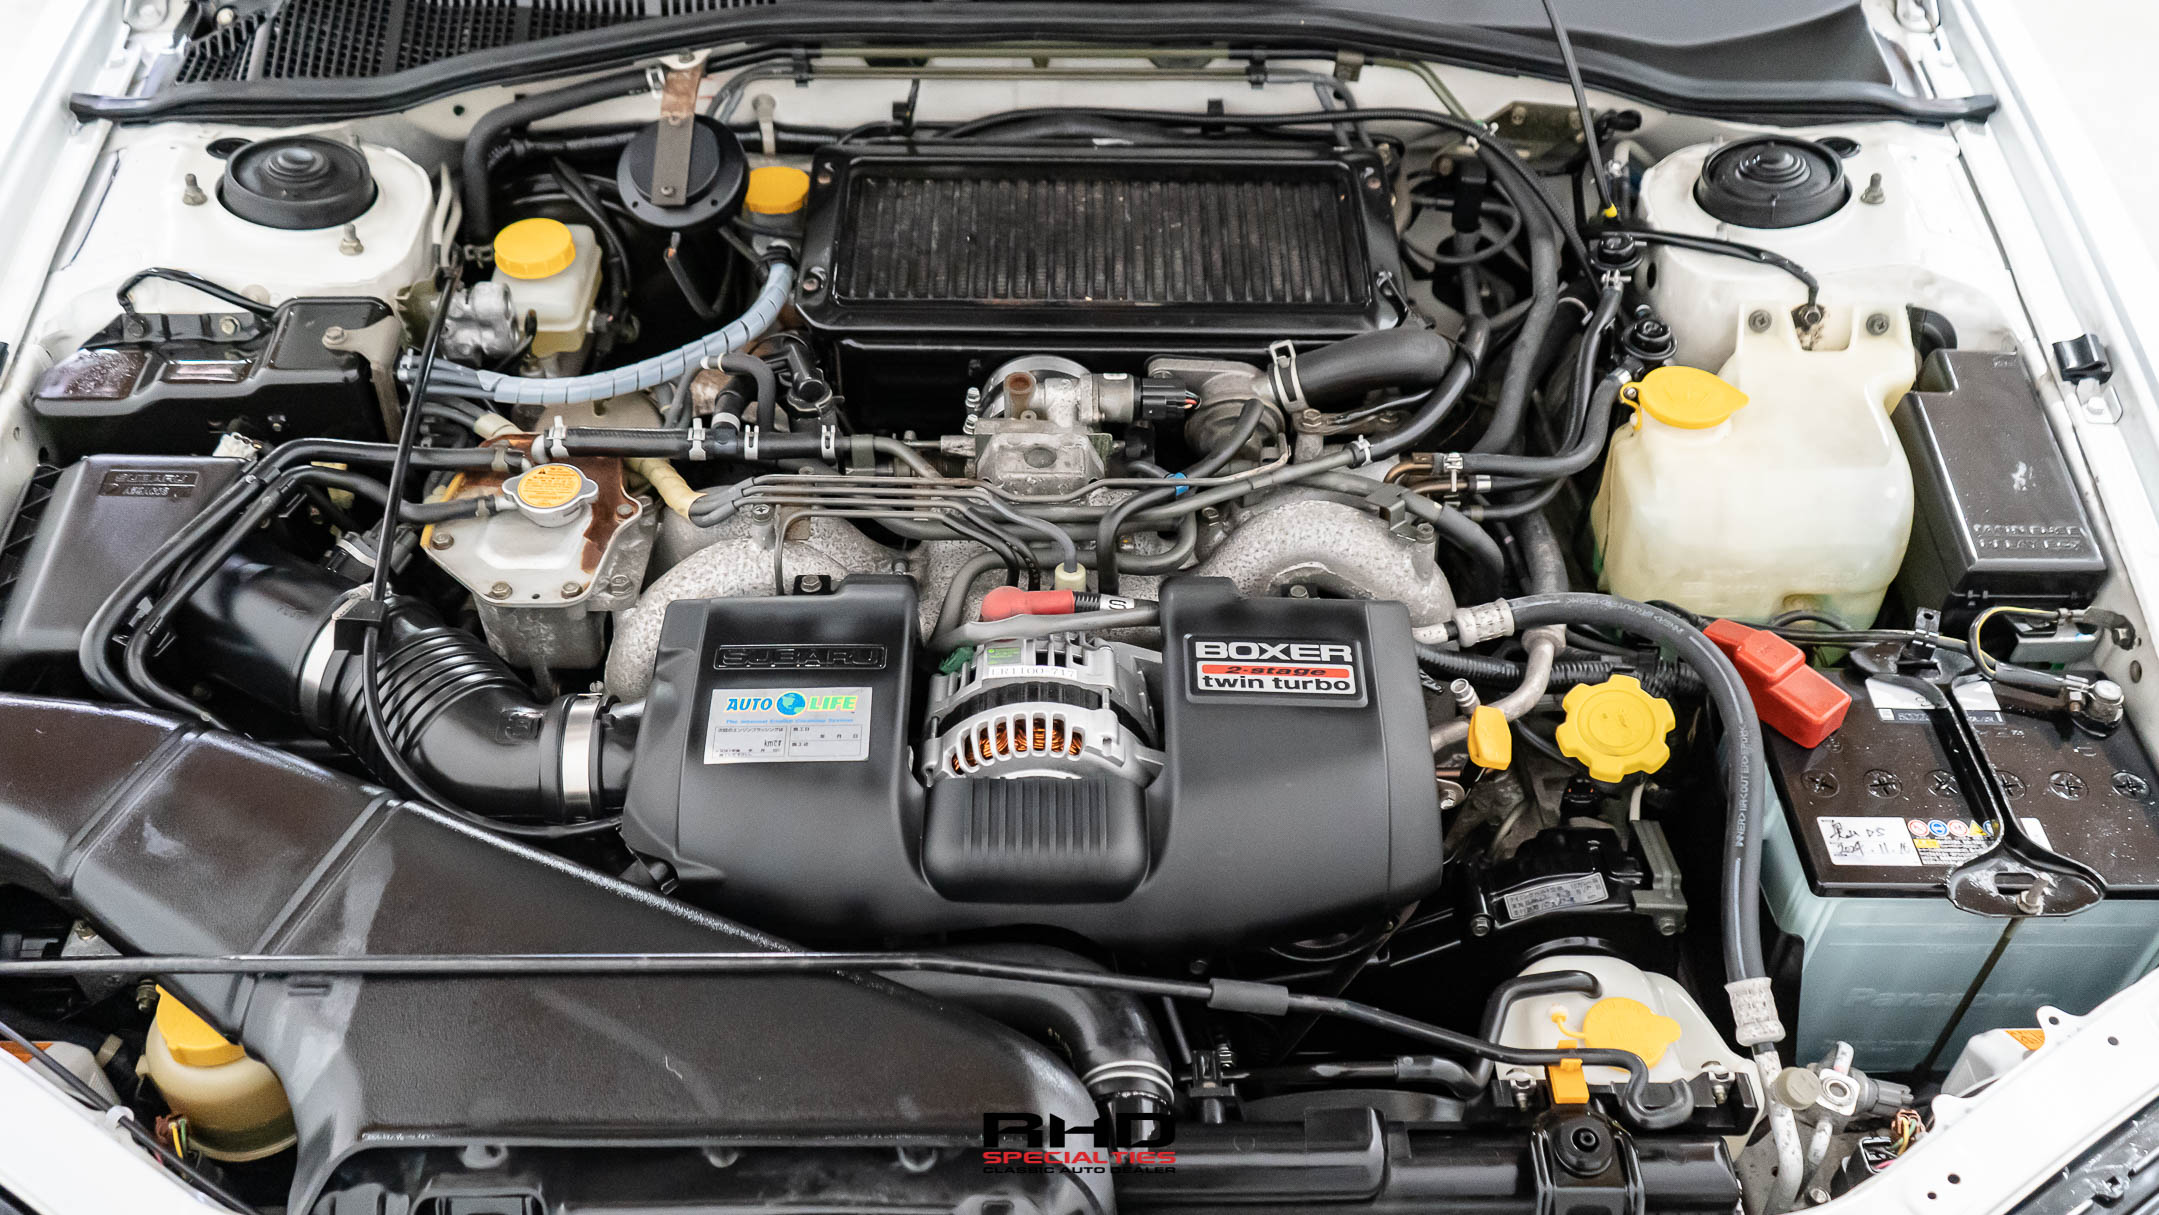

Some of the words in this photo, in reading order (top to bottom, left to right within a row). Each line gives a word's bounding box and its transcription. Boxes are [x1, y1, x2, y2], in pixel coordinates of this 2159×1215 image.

[722, 648, 880, 668] SUBARU
[1195, 641, 1353, 662] BOXER
[1225, 666, 1327, 677] 2-stage
[1202, 675, 1265, 689] twin
[1272, 678, 1350, 692] turbo
[725, 697, 774, 712] AUTO
[807, 695, 858, 711] LIFE
